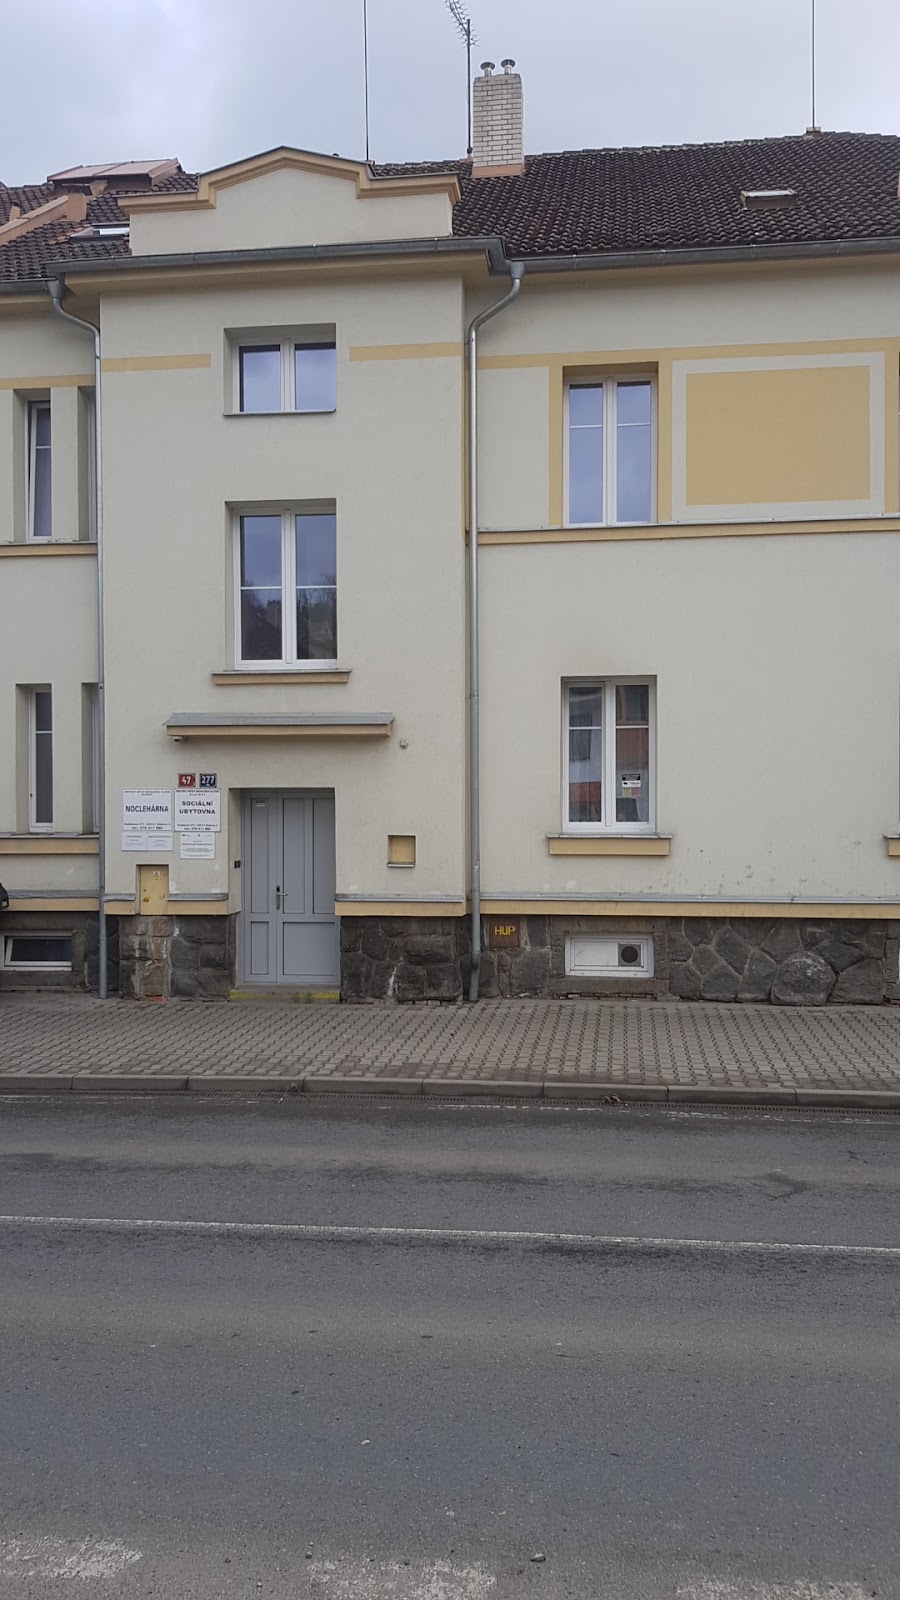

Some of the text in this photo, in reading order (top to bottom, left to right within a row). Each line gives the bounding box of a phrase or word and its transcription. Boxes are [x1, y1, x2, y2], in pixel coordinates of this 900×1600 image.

[182, 776, 191, 785] 47
[201, 776, 215, 784] 277
[126, 804, 169, 812] NOCLEHÁRNA
[495, 926, 515, 935] HUP
